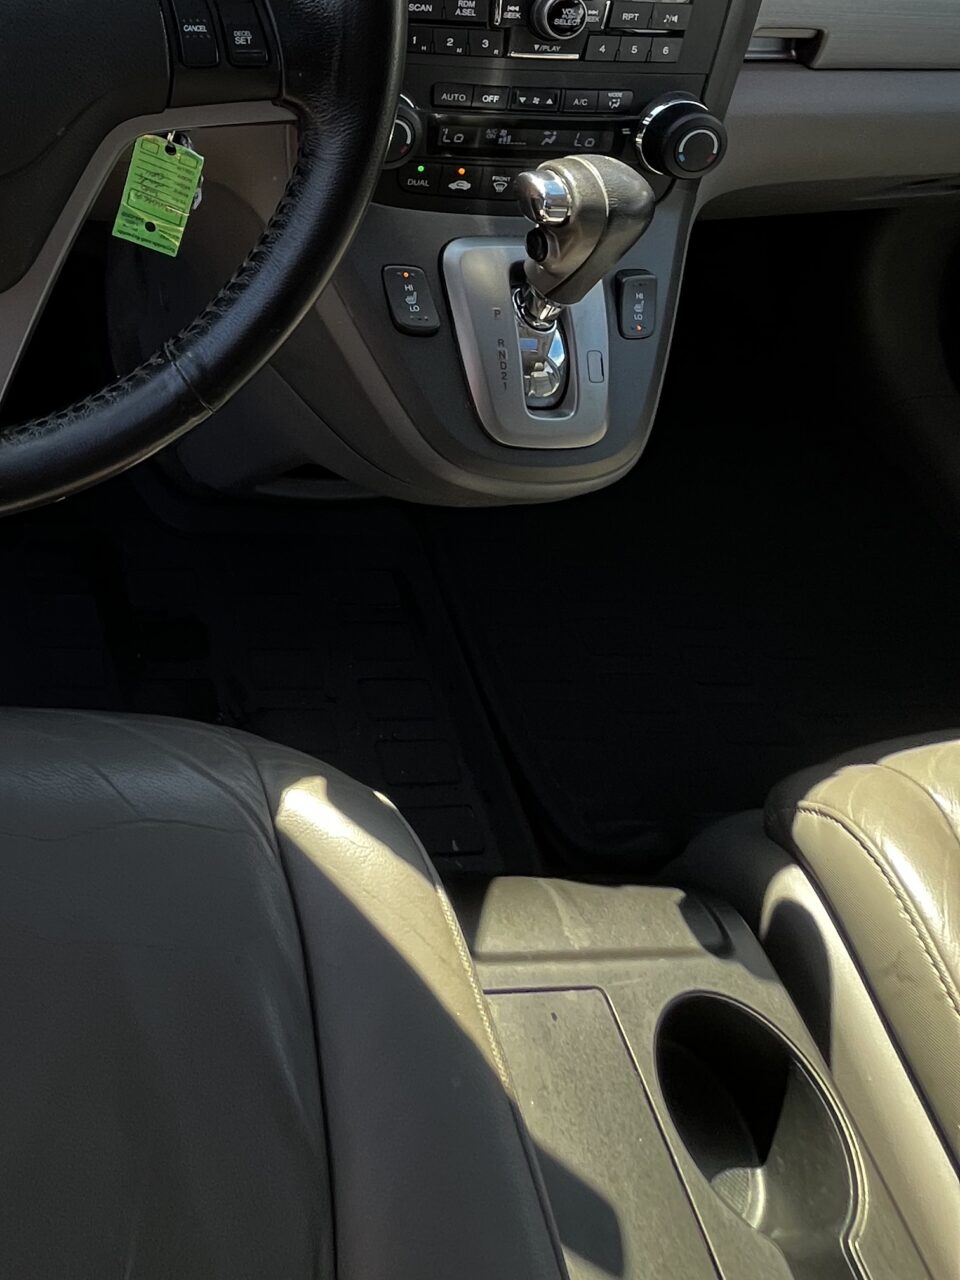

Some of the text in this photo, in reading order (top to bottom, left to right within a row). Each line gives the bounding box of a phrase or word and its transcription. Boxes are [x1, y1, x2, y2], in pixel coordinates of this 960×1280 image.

[408, 3, 433, 12] SCAN
[458, 0, 476, 8] RDM
[622, 13, 640, 21] RPT
[554, 18, 582, 26] SELECT
[183, 25, 207, 33] CANCEL
[413, 36, 417, 44] 1
[446, 38, 454, 46] 2
[481, 40, 489, 48] 3
[599, 45, 606, 53] 4
[631, 45, 638, 54] 5
[662, 46, 669, 54] 6
[441, 93, 466, 102] AUTO
[482, 95, 499, 103] OFF
[572, 98, 588, 106] A/C
[407, 178, 430, 187] DUAL
[404, 284, 414, 292] HI
[493, 310, 501, 318] P
[497, 338, 505, 348] R
[498, 350, 506, 360] N
[500, 361, 507, 371] D
[500, 371, 508, 381] 2
